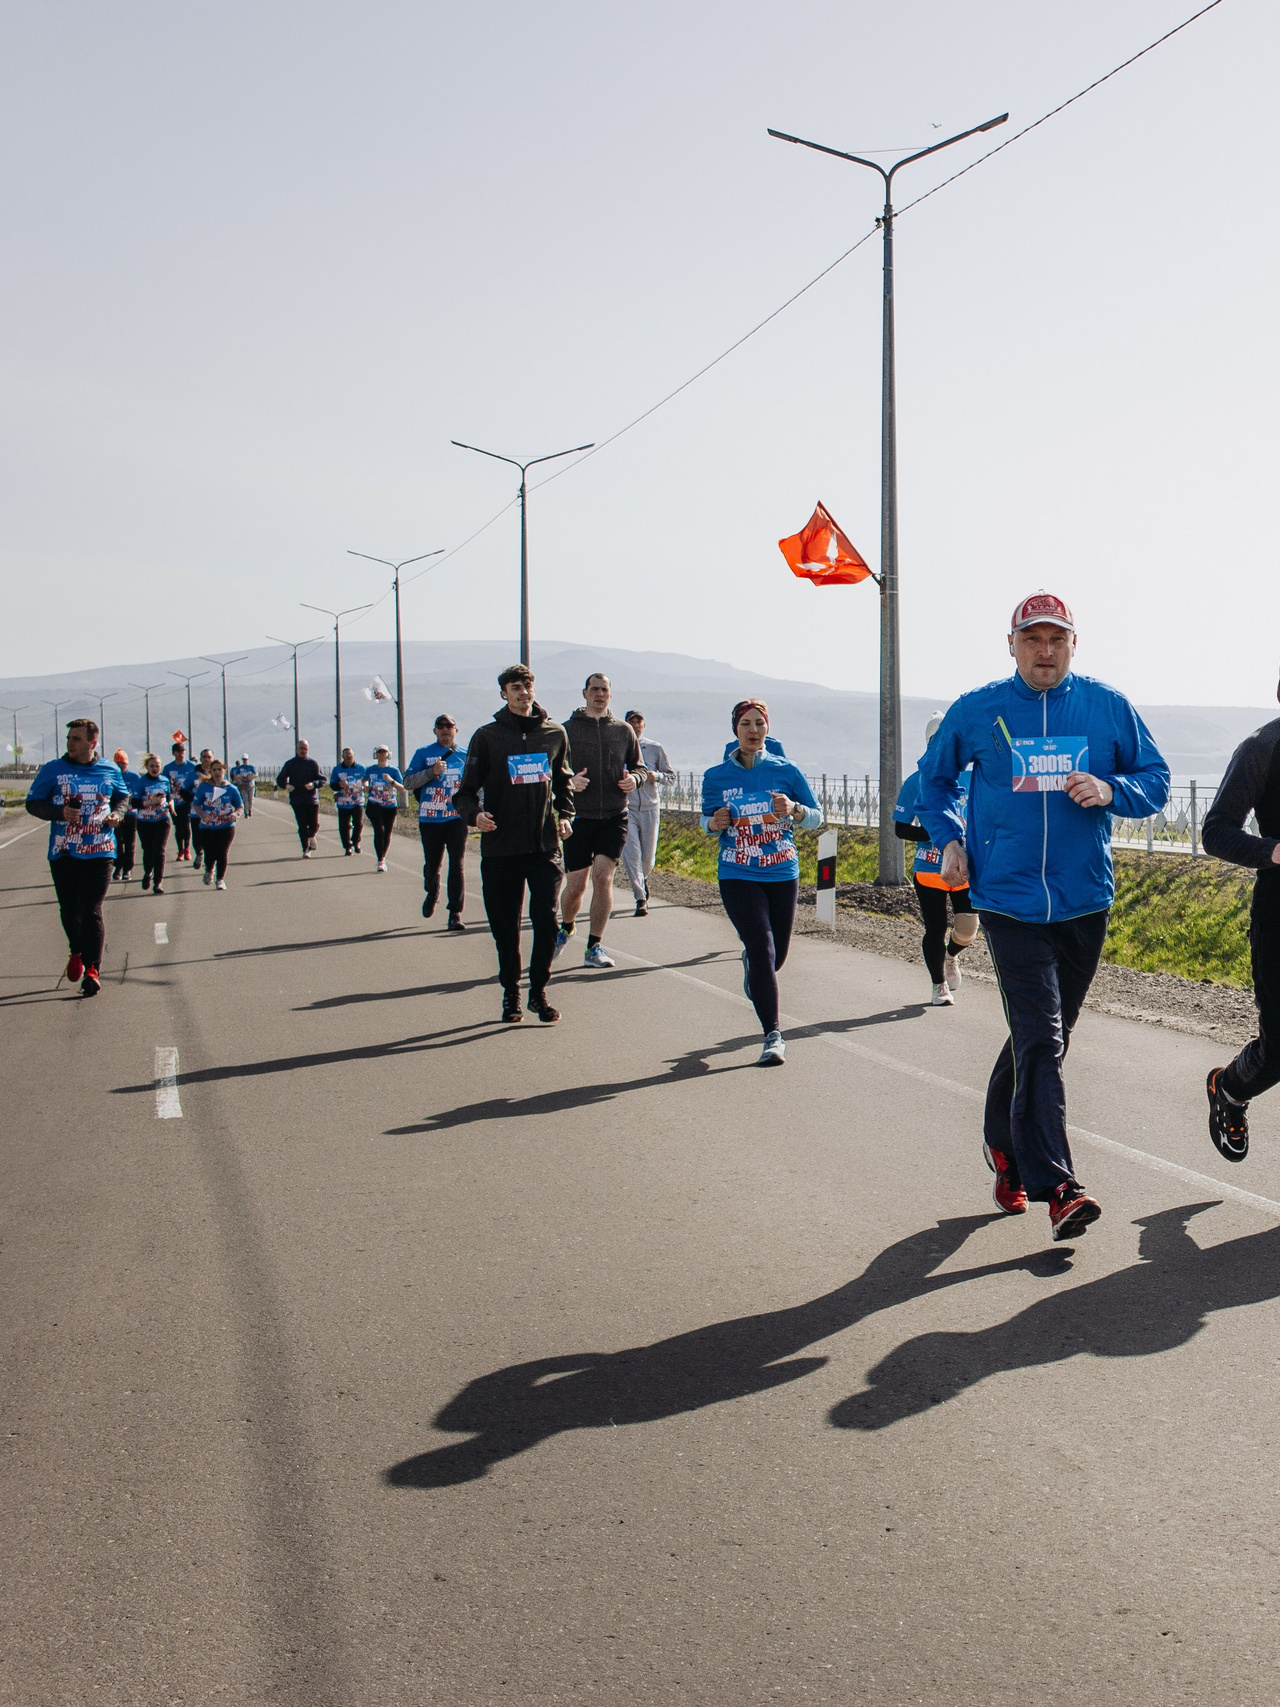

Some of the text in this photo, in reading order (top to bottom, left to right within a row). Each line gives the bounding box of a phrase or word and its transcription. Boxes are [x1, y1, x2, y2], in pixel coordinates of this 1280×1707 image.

[517, 763, 544, 775] 30004
[1028, 754, 1072, 774] 30015
[740, 802, 768, 816] 20020
[722, 849, 750, 866] #ЗАБЕГ
